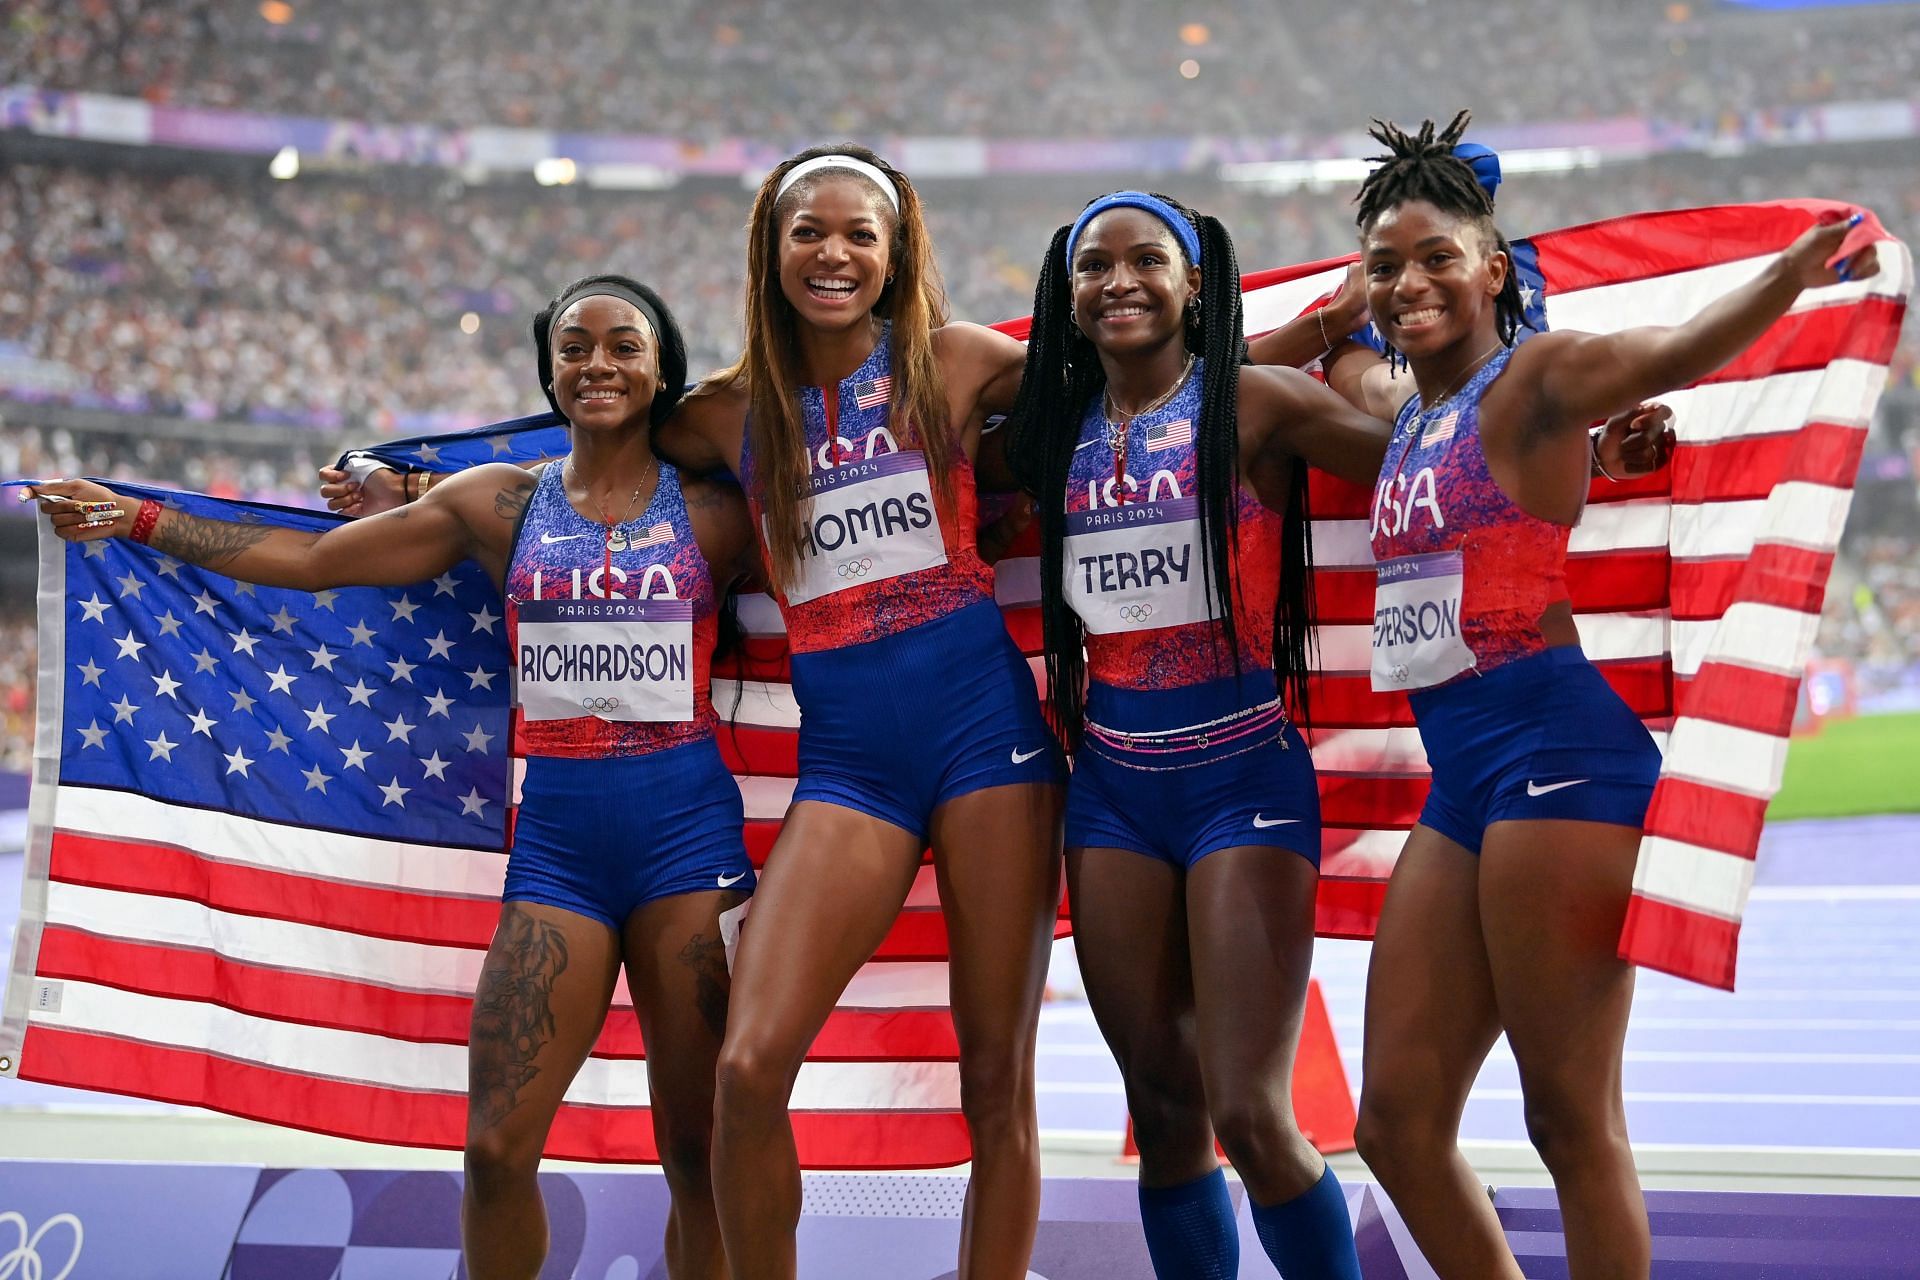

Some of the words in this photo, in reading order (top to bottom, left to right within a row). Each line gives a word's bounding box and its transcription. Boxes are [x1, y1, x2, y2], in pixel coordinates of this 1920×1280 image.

[803, 427, 899, 475] SA
[840, 463, 878, 481] 2024
[795, 492, 932, 561] HOMAS
[1086, 512, 1124, 527] PARIS
[1128, 507, 1164, 521] 2024
[1078, 543, 1191, 594] TERRY
[557, 604, 601, 616] PARIS
[605, 605, 646, 616] 2024
[521, 643, 686, 682] RICHARDSON
